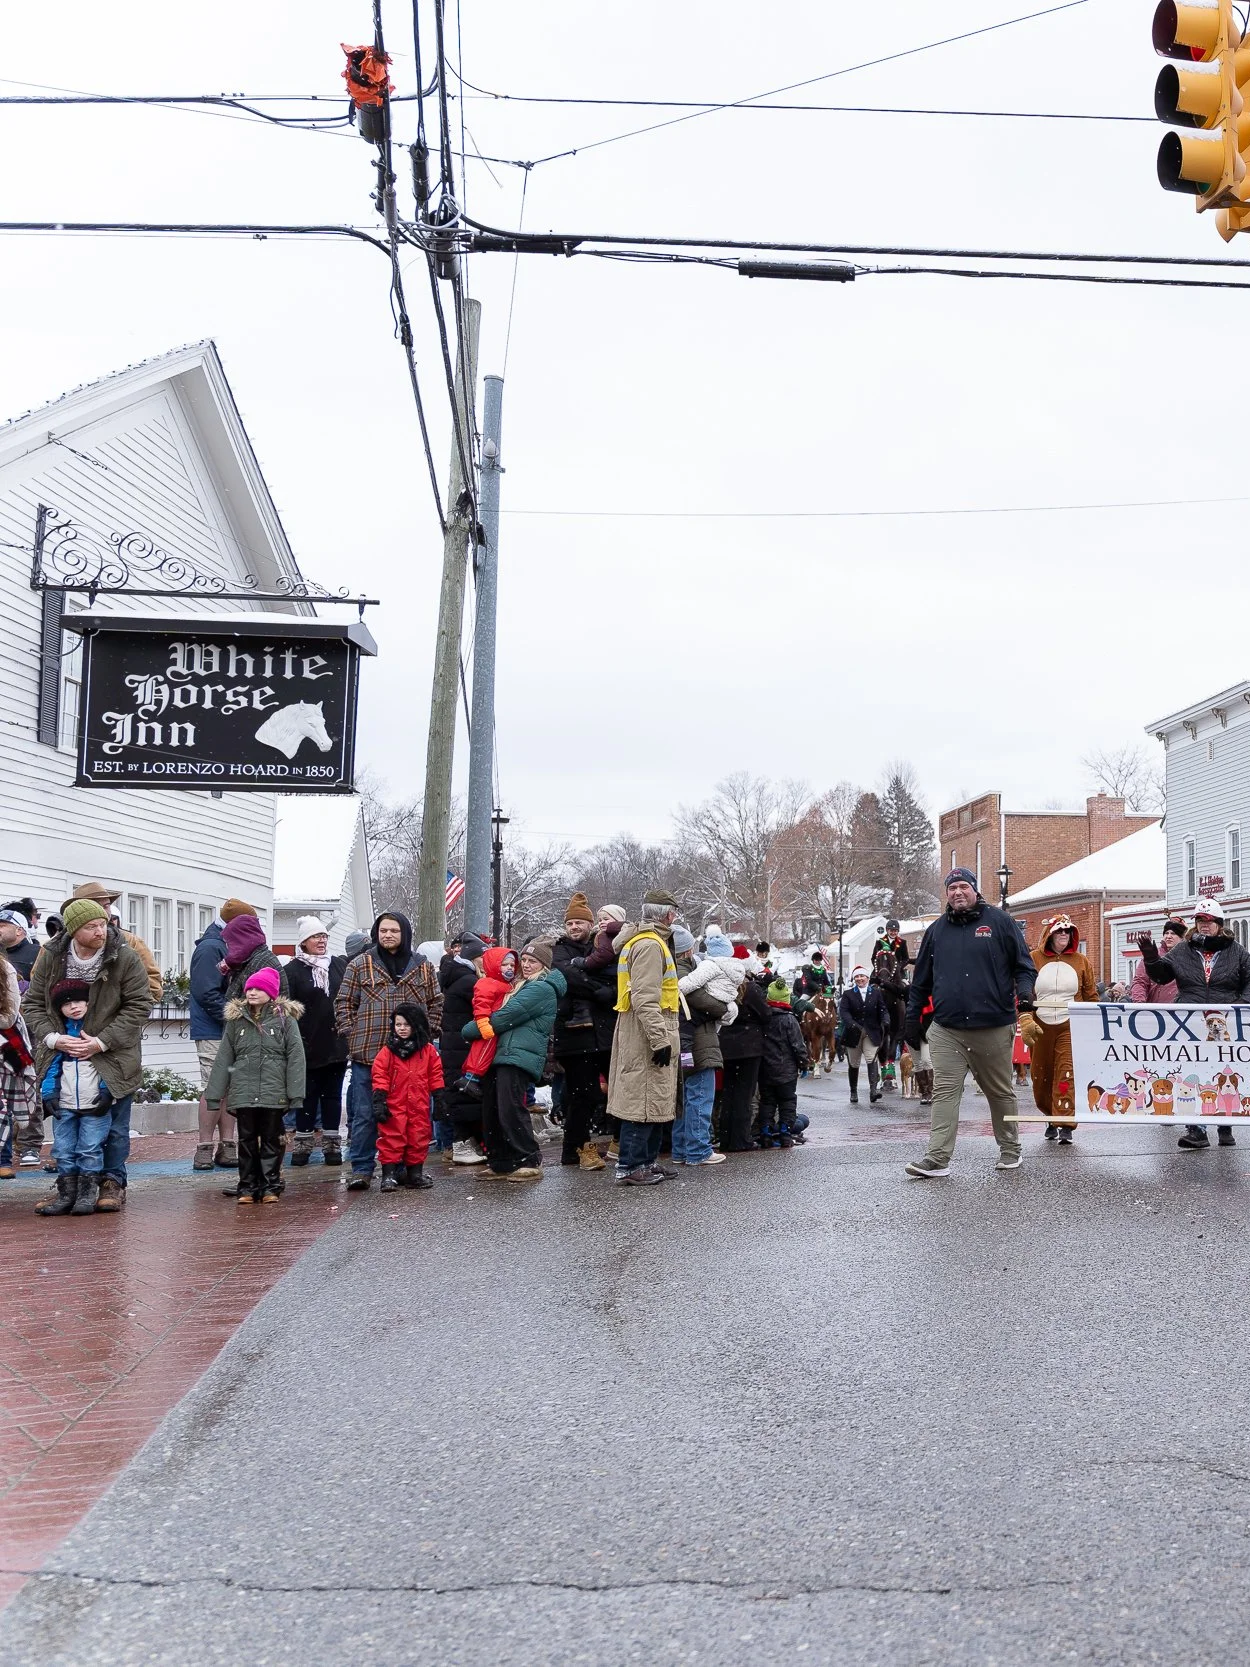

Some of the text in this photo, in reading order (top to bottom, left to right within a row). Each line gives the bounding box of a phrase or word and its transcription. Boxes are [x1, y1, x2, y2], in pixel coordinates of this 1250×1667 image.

[165, 642, 334, 681] White
[124, 673, 280, 720] Horse
[101, 711, 196, 754] Inn
[94, 761, 335, 778] EST. BY LORENZO HOARD IN 1850
[1097, 1004, 1201, 1042] FOX
[1102, 1044, 1209, 1062] ANIMAL
